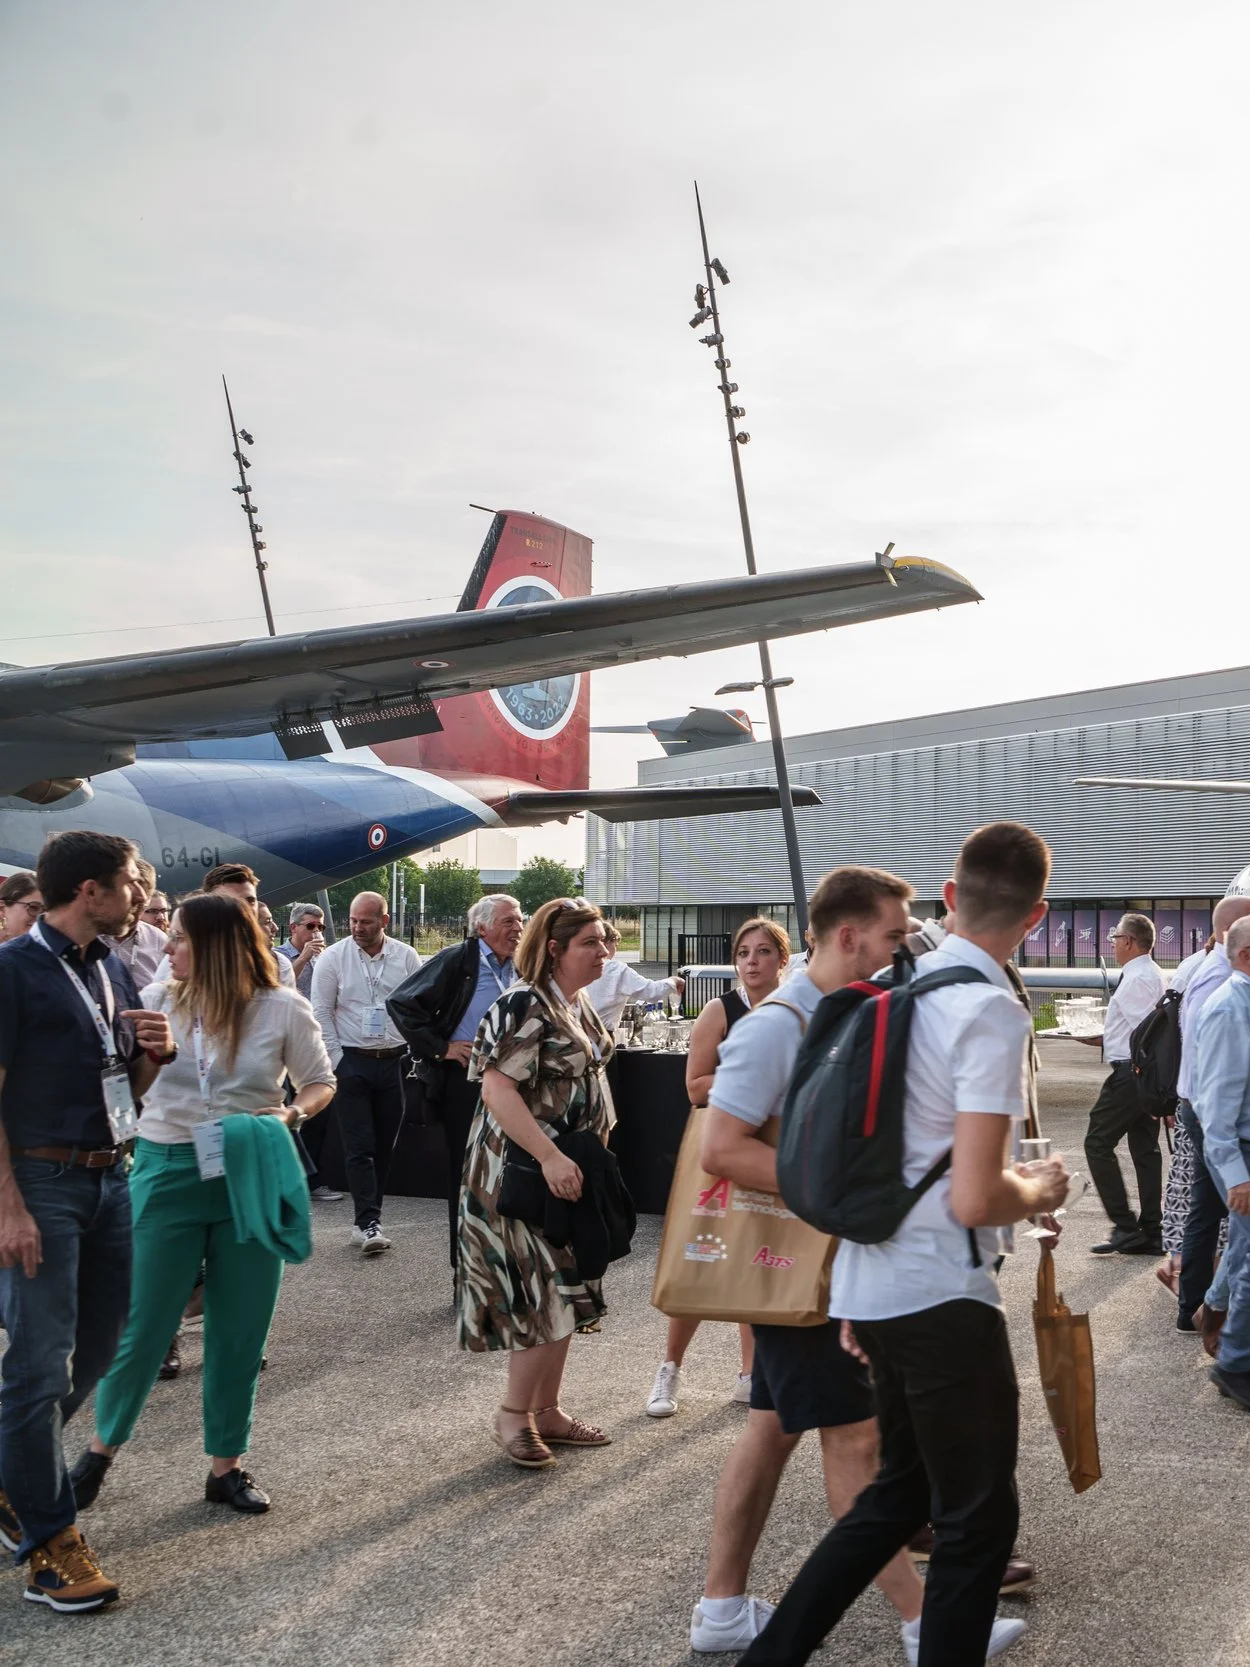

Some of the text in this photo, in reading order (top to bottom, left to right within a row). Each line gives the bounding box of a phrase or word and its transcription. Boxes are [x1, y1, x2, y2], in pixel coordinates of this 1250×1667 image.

[505, 687, 566, 724] 1963 2022
[752, 1246, 796, 1268] A3TS
